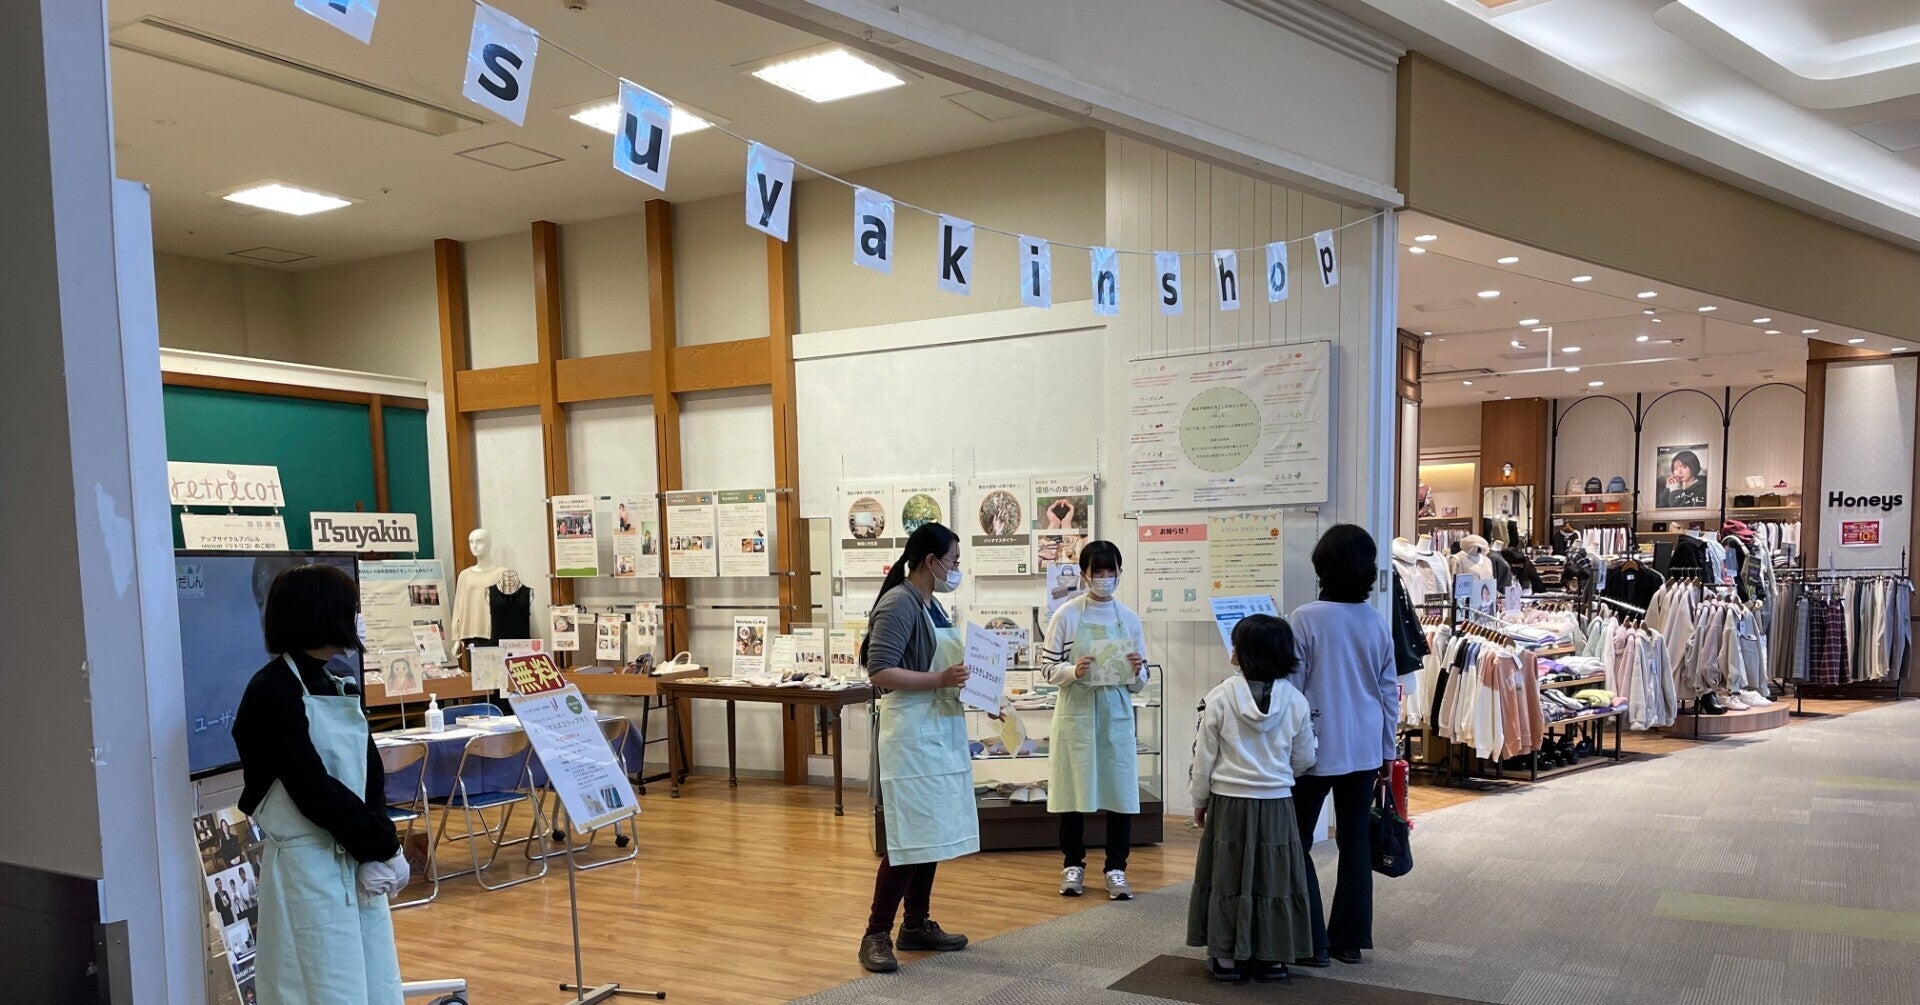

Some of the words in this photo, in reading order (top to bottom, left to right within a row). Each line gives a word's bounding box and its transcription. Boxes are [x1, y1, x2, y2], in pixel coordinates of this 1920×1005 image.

[1035, 485, 1089, 494] 環境への取り組み
[1829, 491, 1903, 511] Honeys
[313, 518, 413, 549] Tsuyakin
[176, 576, 204, 590] だしん
[508, 655, 563, 695] 無料
[194, 708, 237, 733] ユーザ
